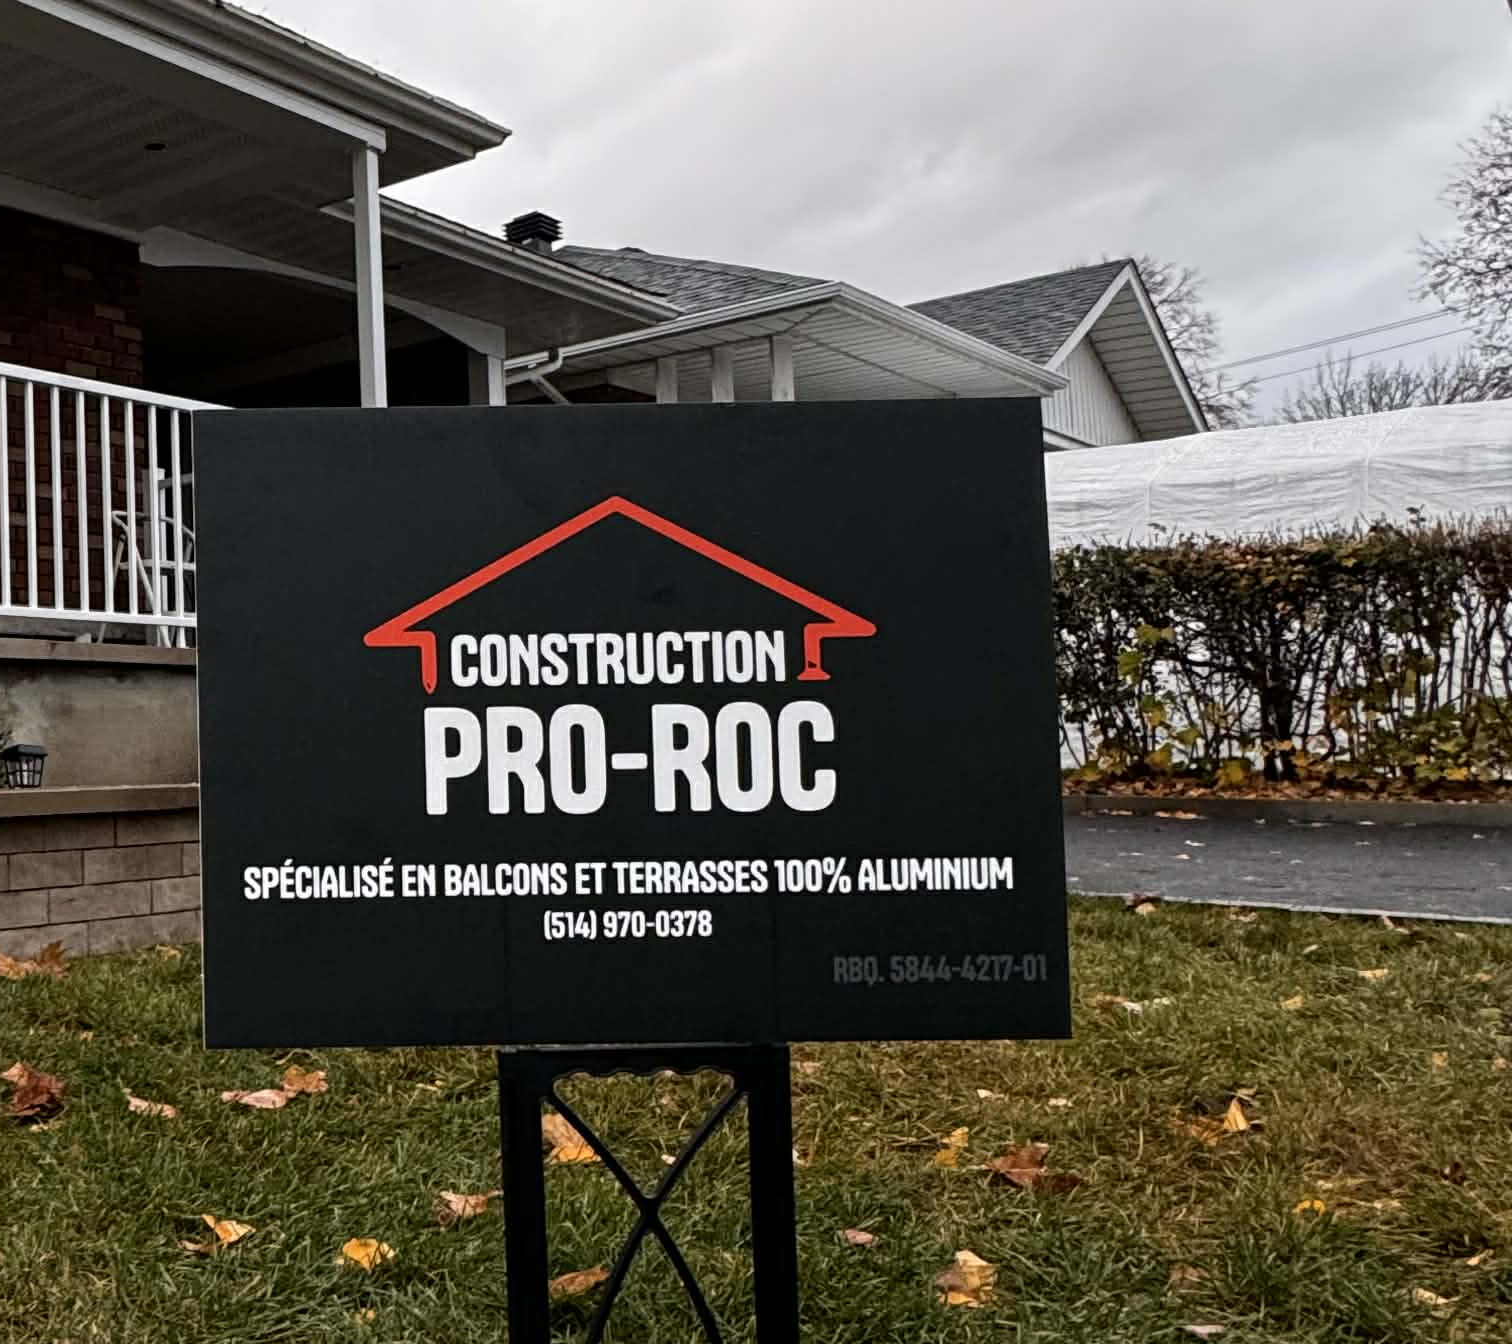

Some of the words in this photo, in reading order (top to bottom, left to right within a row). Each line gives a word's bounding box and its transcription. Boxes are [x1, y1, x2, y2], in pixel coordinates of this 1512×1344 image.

[451, 630, 786, 687] CONSTRUCTION
[424, 701, 836, 815] PRO-ROC
[244, 857, 394, 899] SPÉCIALISÉ
[402, 864, 437, 897] EN
[445, 863, 567, 896] BALCONS
[575, 862, 606, 894] ET
[612, 860, 768, 894] TERRASSES
[774, 857, 851, 893] 100%
[858, 857, 1013, 891] ALUMINIUM
[544, 910, 596, 940] (514)
[603, 910, 713, 938] 970-0378
[834, 957, 885, 986] RBQ.
[890, 955, 1047, 983] 5844-4217-01
